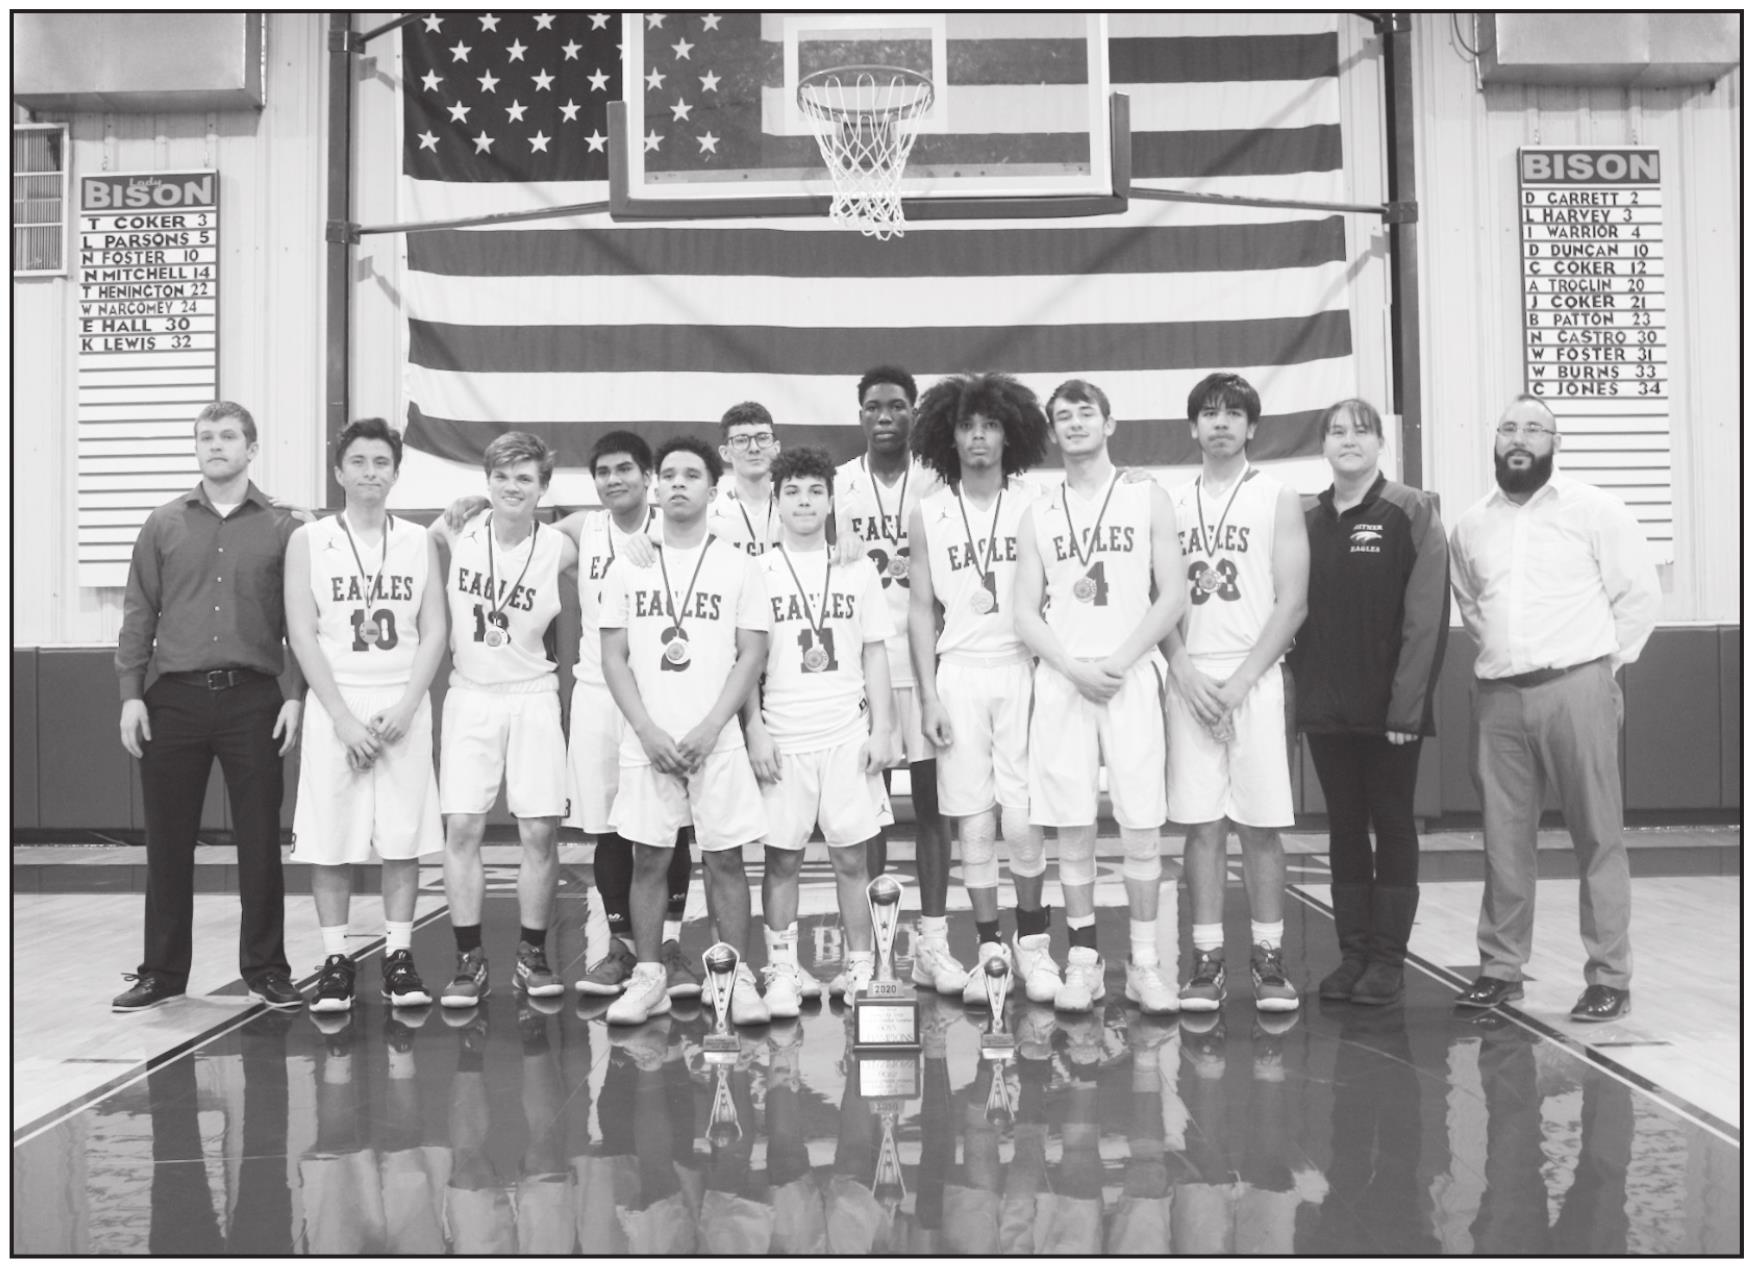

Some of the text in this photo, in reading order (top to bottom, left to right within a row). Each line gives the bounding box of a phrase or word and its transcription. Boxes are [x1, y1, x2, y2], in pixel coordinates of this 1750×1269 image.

[1523, 153, 1659, 181] BISON
[84, 176, 212, 209] BISON
[1525, 192, 1639, 205] D GARRETT 2
[88, 213, 208, 230] T COKER 3
[1526, 208, 1632, 223] L HARVEY 3
[1528, 225, 1641, 239] I WARRIOR 4
[83, 231, 210, 249] L PARSONS 5
[82, 248, 199, 265] N FOSTER 10
[1529, 244, 1649, 257] D DUNCAN 10
[84, 266, 210, 282] N MITCHELL 14
[1529, 260, 1646, 274] C COKER 12
[83, 282, 208, 299] T HENINGTON 22
[1529, 279, 1645, 292] A TROGLIN 20
[81, 300, 197, 315] W NARCOMEY 24
[1531, 295, 1645, 309] J COKER 21
[83, 317, 190, 333] E HALL 30
[1529, 312, 1651, 326] B PATTON 23
[82, 335, 192, 351] K LEWIS 32
[1531, 330, 1657, 345] N CASTRO 30
[1532, 347, 1652, 361] W FOSTER 31
[1532, 365, 1656, 379] W BURNS 33
[1532, 382, 1661, 396] C JONES 34
[331, 574, 414, 602] EALES
[771, 592, 856, 623] EAES
[350, 608, 399, 652] 10
